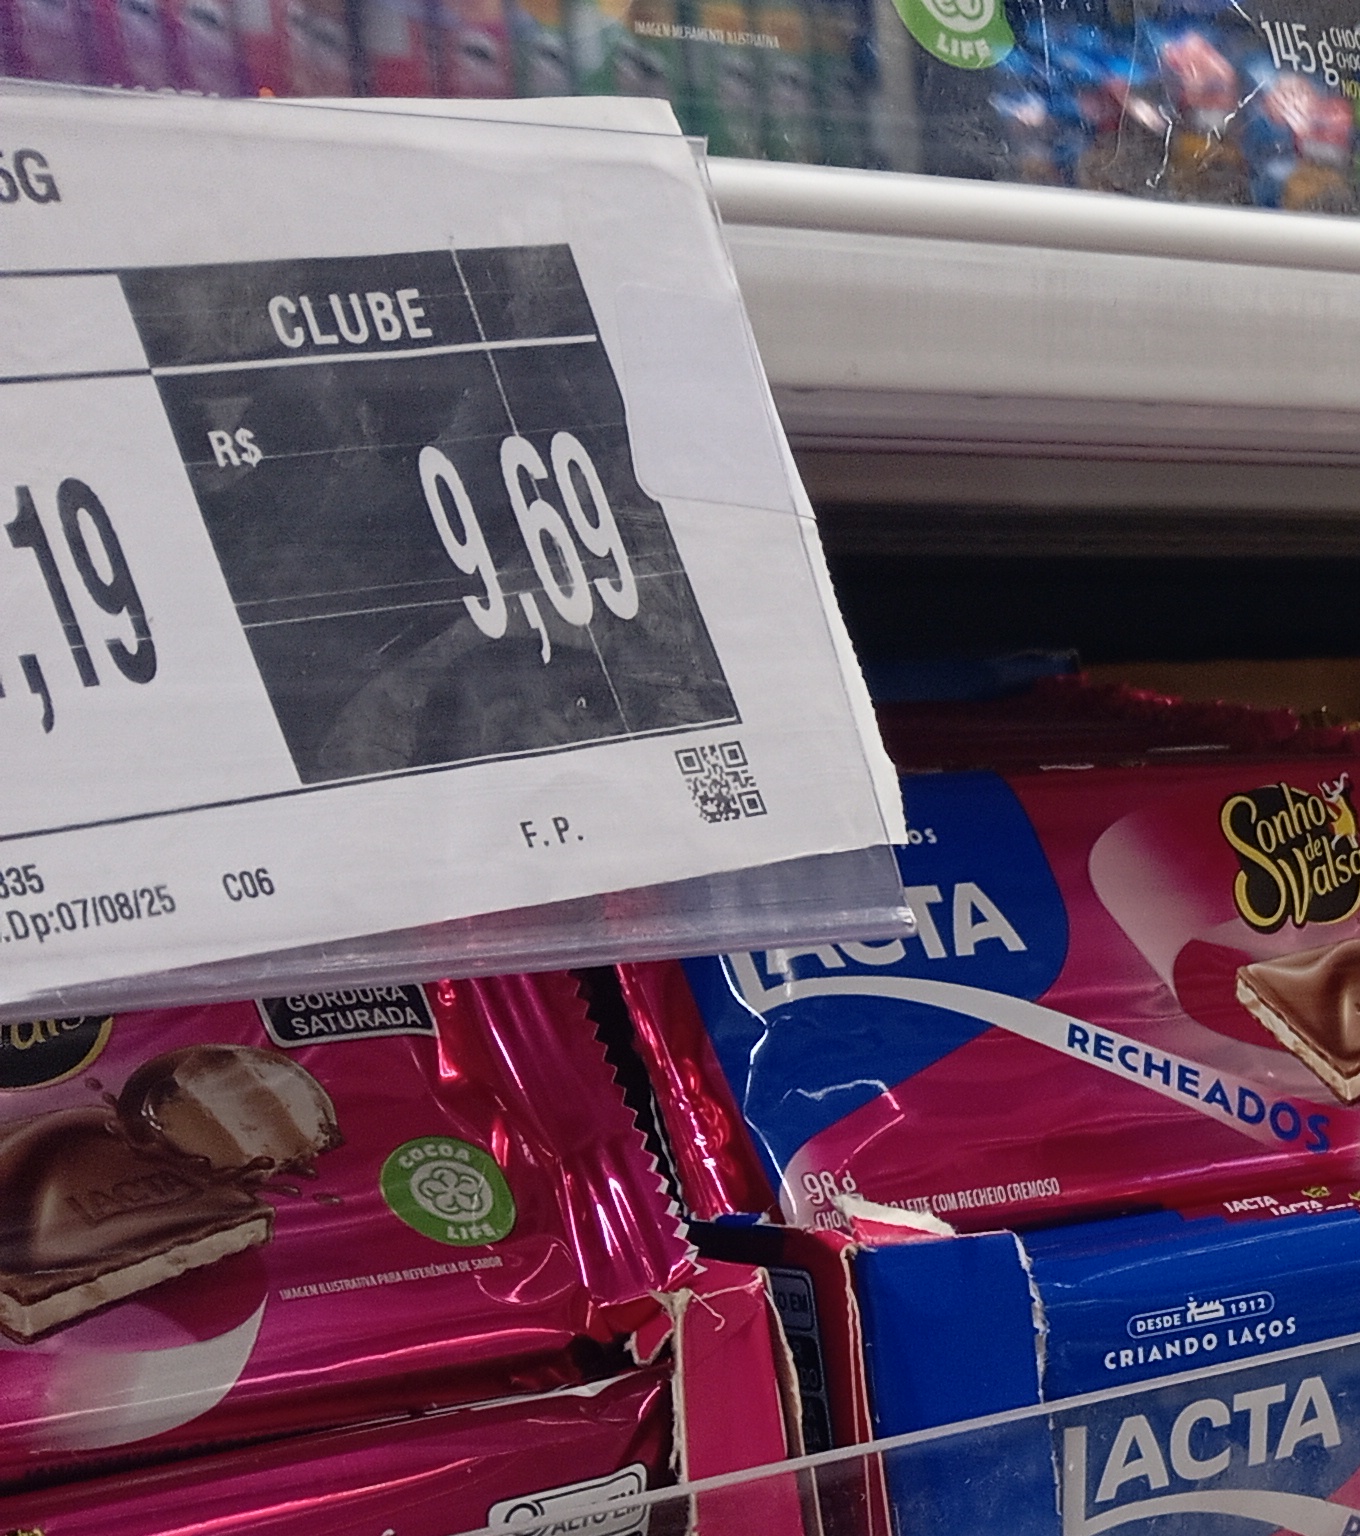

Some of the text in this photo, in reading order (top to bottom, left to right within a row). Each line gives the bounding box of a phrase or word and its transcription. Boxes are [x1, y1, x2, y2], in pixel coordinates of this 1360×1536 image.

[936, 33, 991, 61] LIFE
[267, 288, 433, 349] CLUBE
[211, 430, 262, 469] R$
[418, 430, 640, 666] 9,69
[222, 867, 275, 902] C06
[291, 1006, 421, 1037] SATURADA
[1066, 1022, 1332, 1155] RECHEADOS
[399, 1142, 470, 1168] COCOA
[957, 1177, 1061, 1209] RECHEIO CREMOSO
[447, 1223, 496, 1241] LIFE
[1136, 1297, 1267, 1333] DESDE 1912
[1103, 1316, 1297, 1371] CRIANDO LAÇOS
